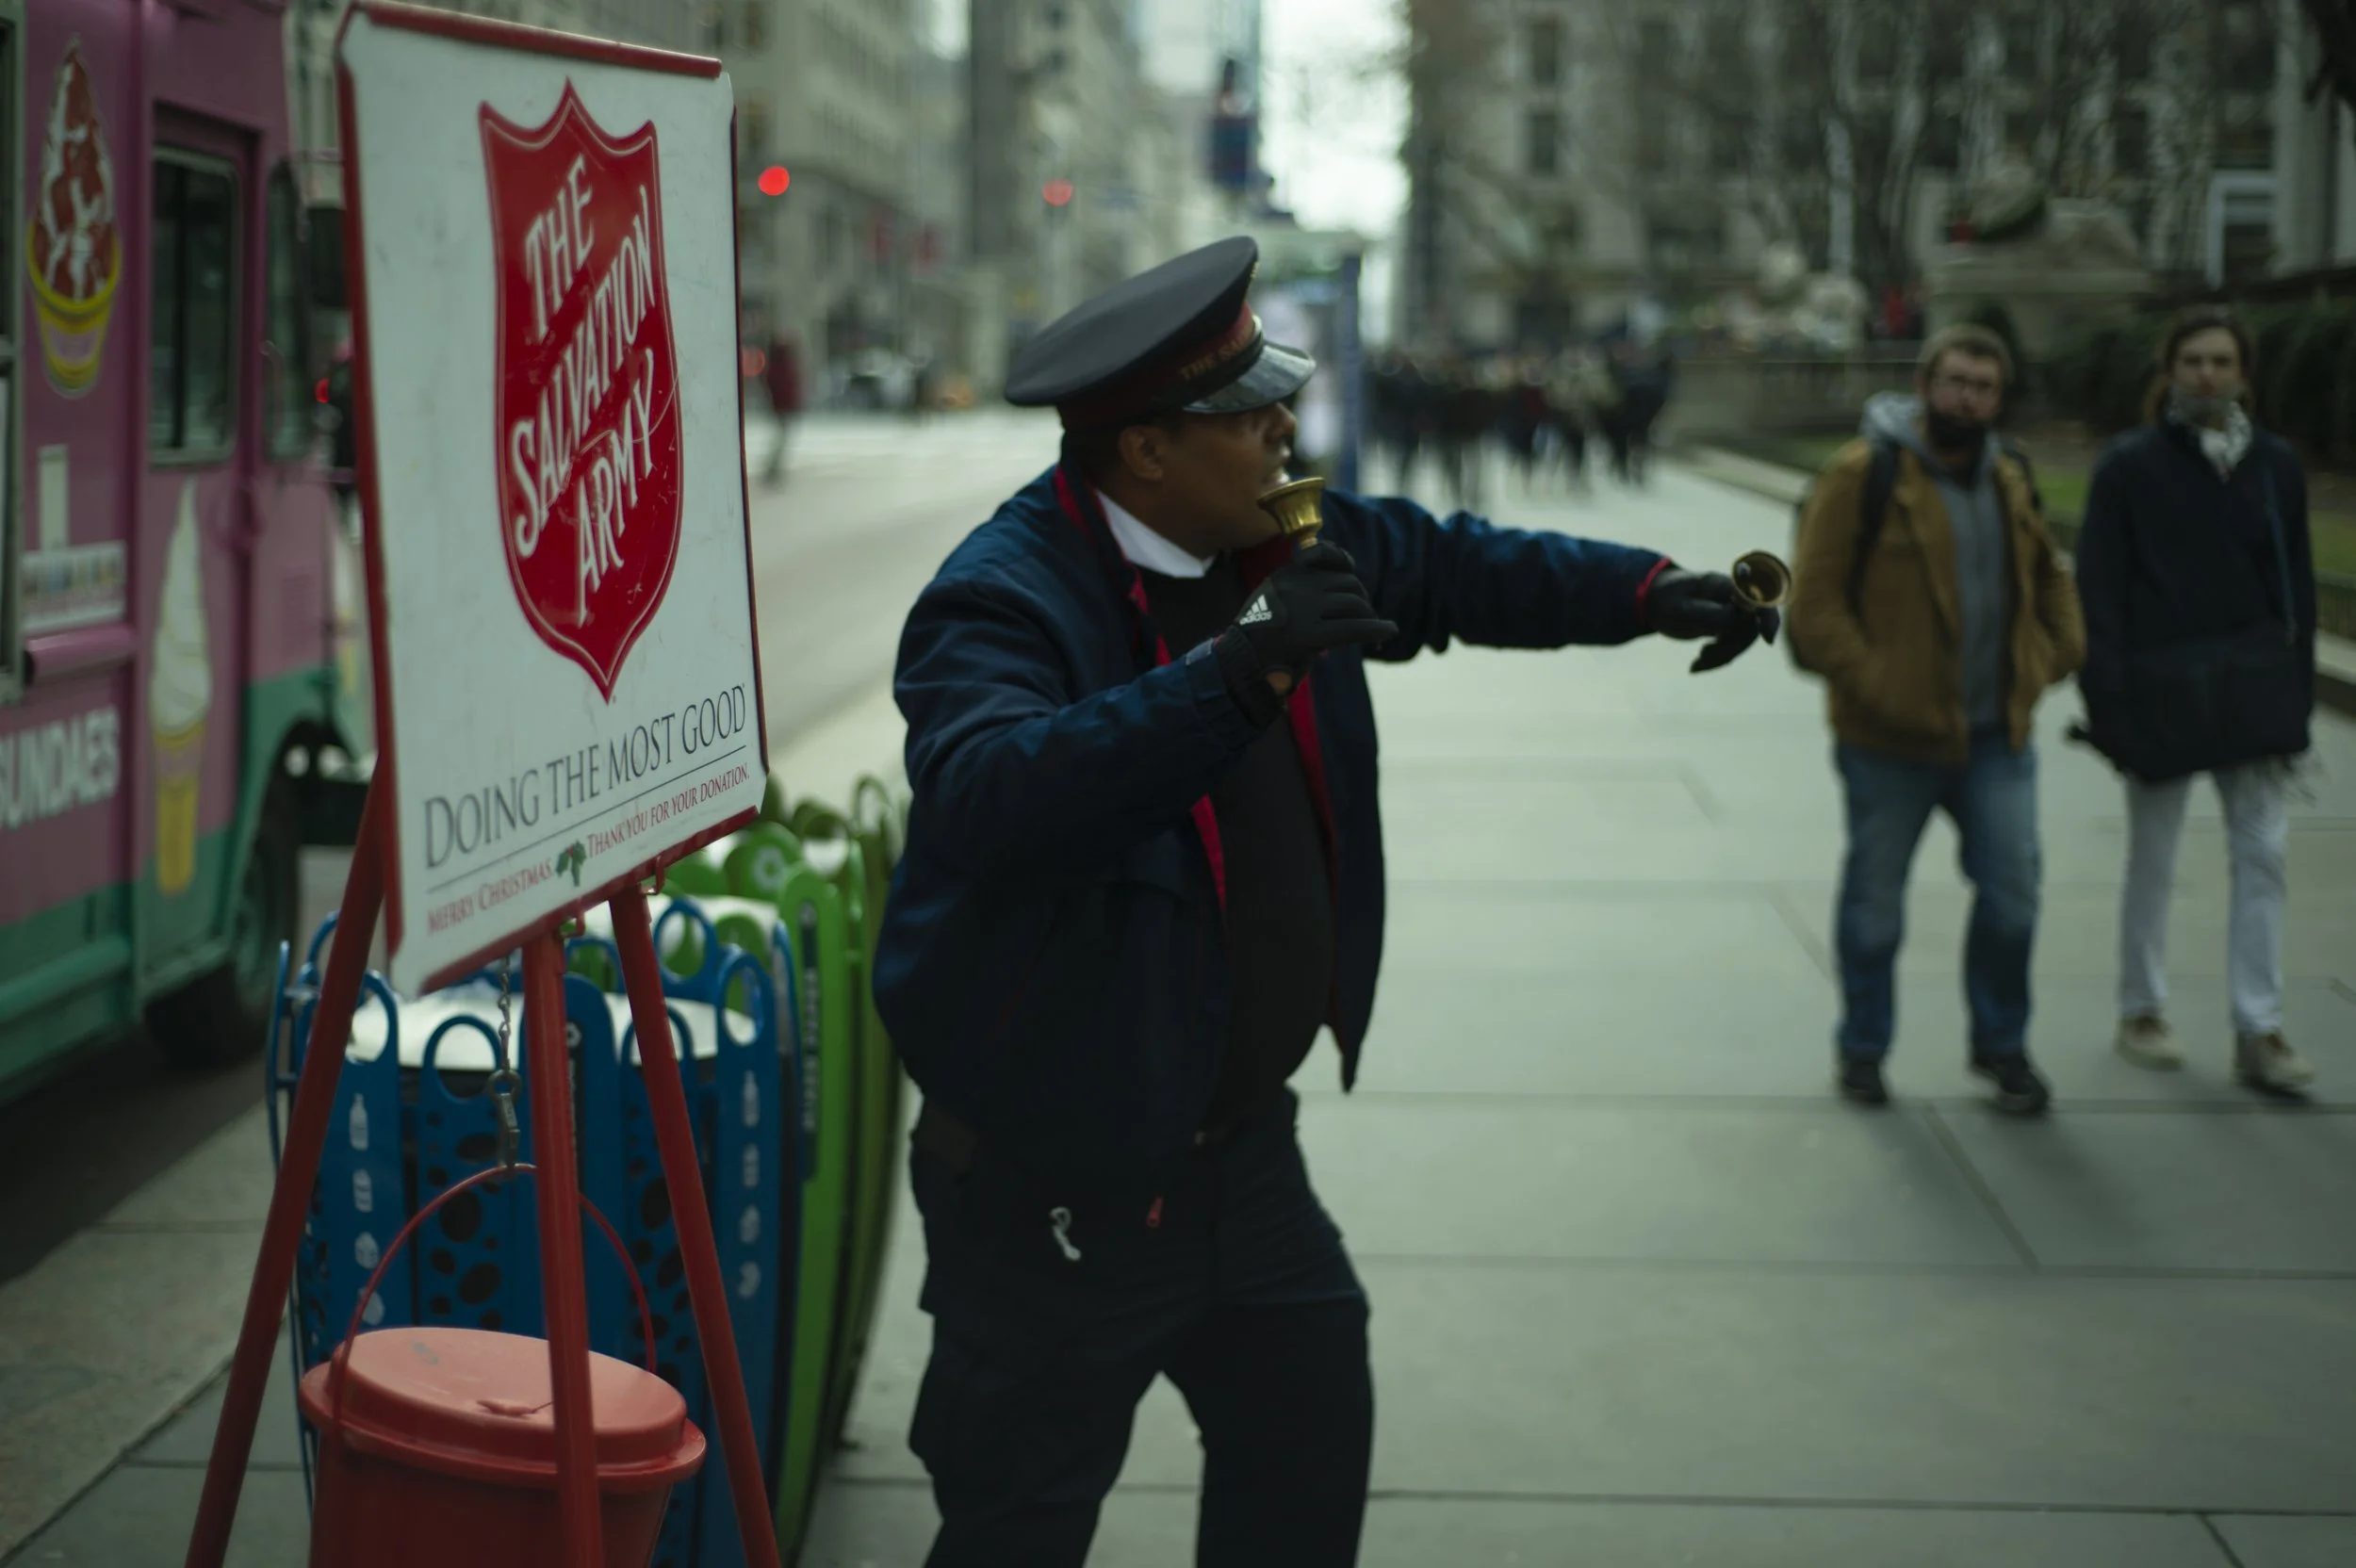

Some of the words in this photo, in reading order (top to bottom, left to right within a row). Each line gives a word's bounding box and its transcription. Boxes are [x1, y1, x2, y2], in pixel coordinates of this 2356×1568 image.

[524, 152, 594, 346] THE
[509, 183, 656, 558] SALVATION
[575, 348, 655, 629] ARMY
[424, 768, 540, 871] DOING
[547, 744, 600, 815] THE
[608, 712, 676, 791] MOST
[682, 684, 746, 755] GOOD
[427, 892, 474, 938] MERRY
[478, 857, 553, 911] CHRISTMAS
[586, 821, 625, 858] THANK
[627, 809, 648, 841] YOU
[651, 800, 670, 827] FOR
[671, 787, 698, 817] YOUR
[699, 762, 751, 803] DONATION.
